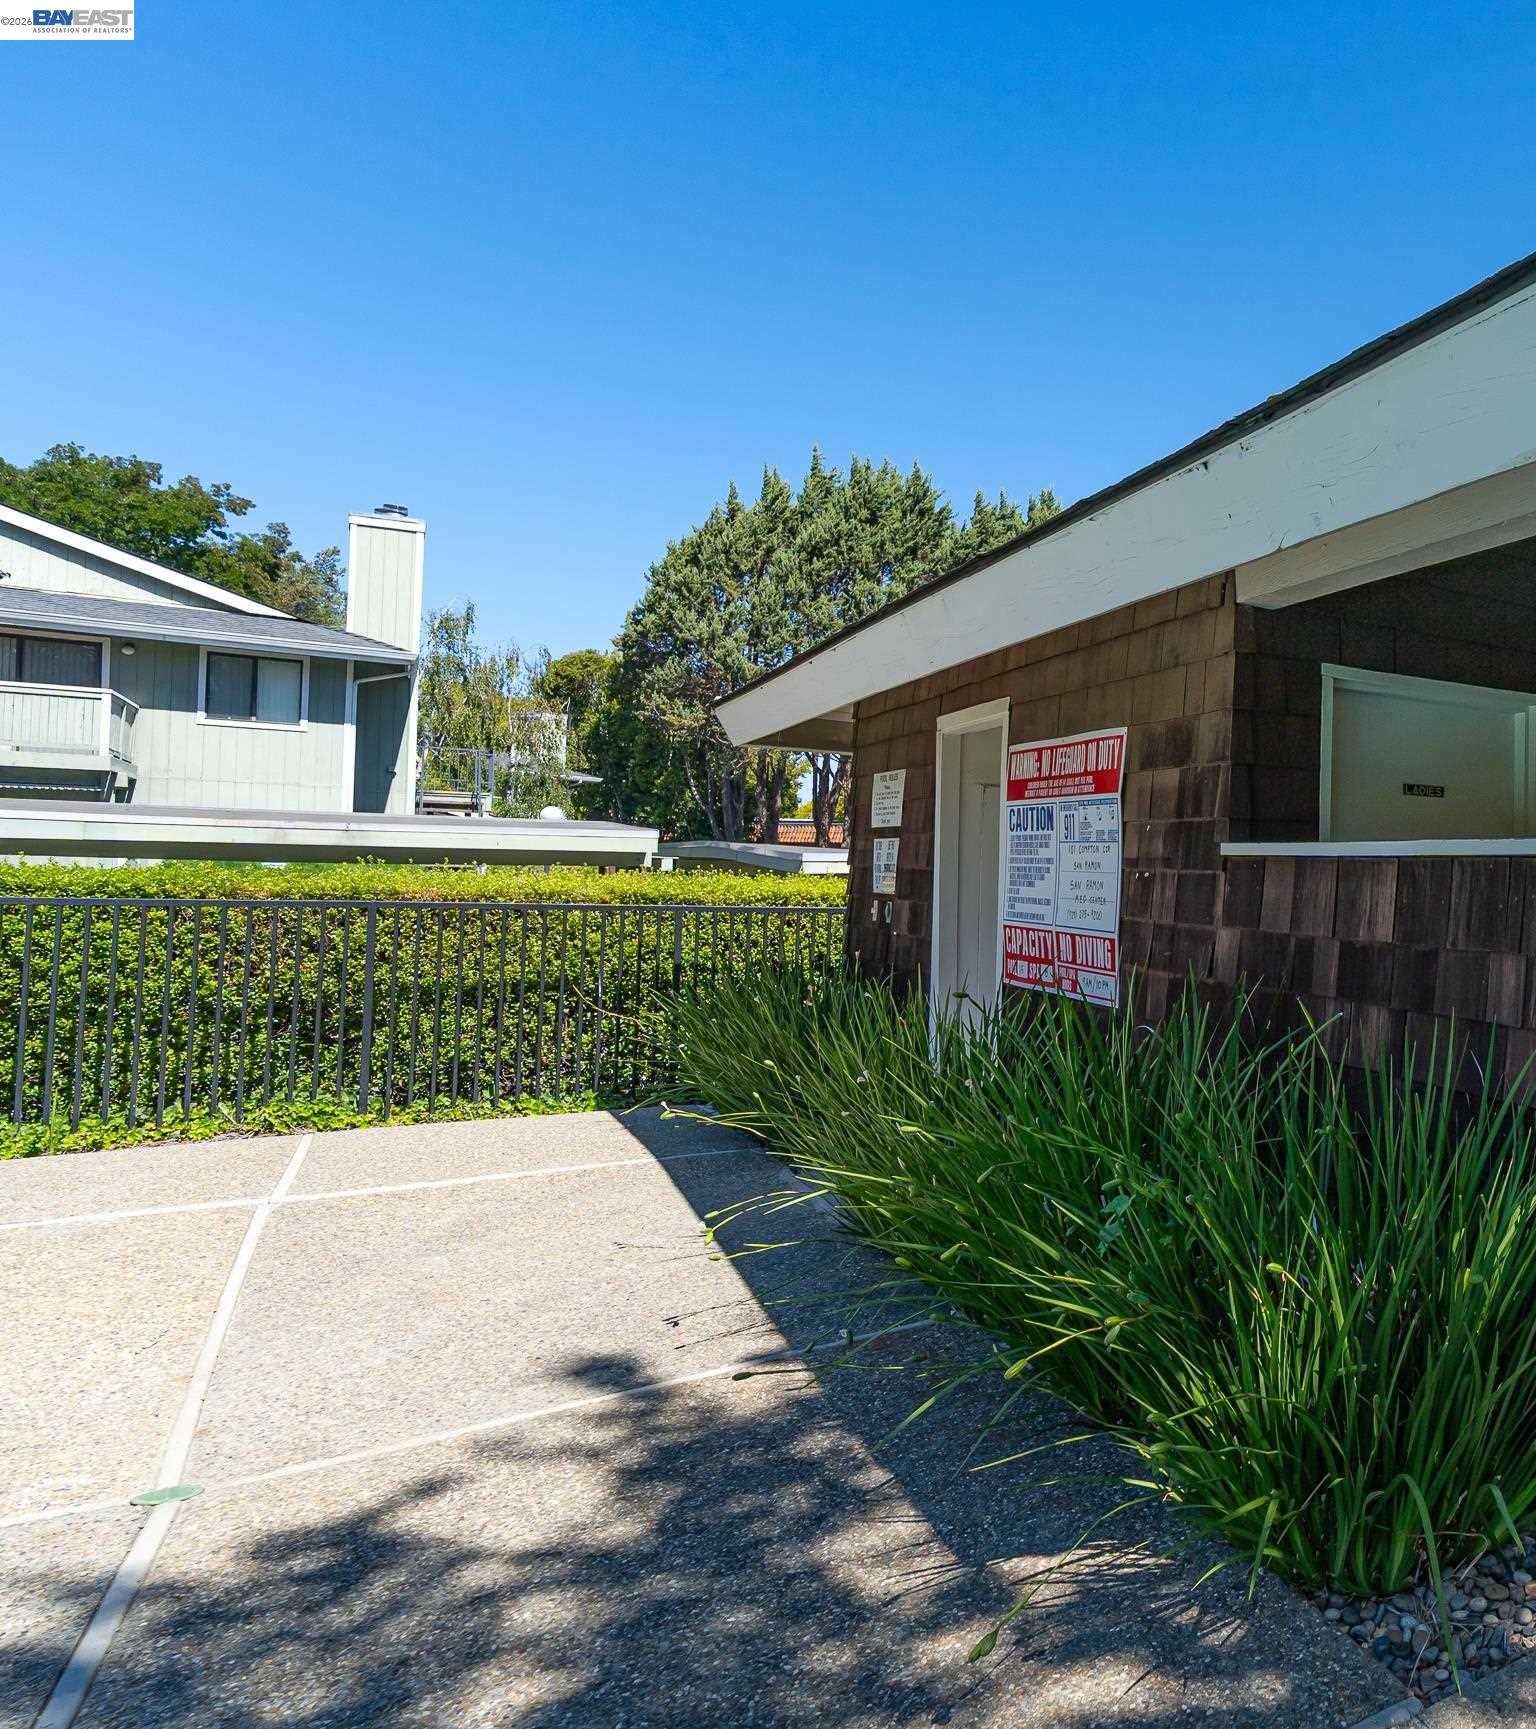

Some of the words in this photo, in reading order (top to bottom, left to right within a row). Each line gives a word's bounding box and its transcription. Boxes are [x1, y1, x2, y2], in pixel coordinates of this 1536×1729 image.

[1041, 749, 1051, 777] NO
[1051, 743, 1087, 776] LIFEGUARD
[1087, 741, 1098, 772] ON
[1098, 738, 1121, 770] DUTY
[1406, 784, 1442, 798] LADIES
[1009, 805, 1054, 832] CAUTION
[1064, 813, 1075, 840] 911
[1005, 927, 1052, 959] CAPACITY
[1059, 933, 1072, 962] NO
[1075, 935, 1112, 970] DIVING
